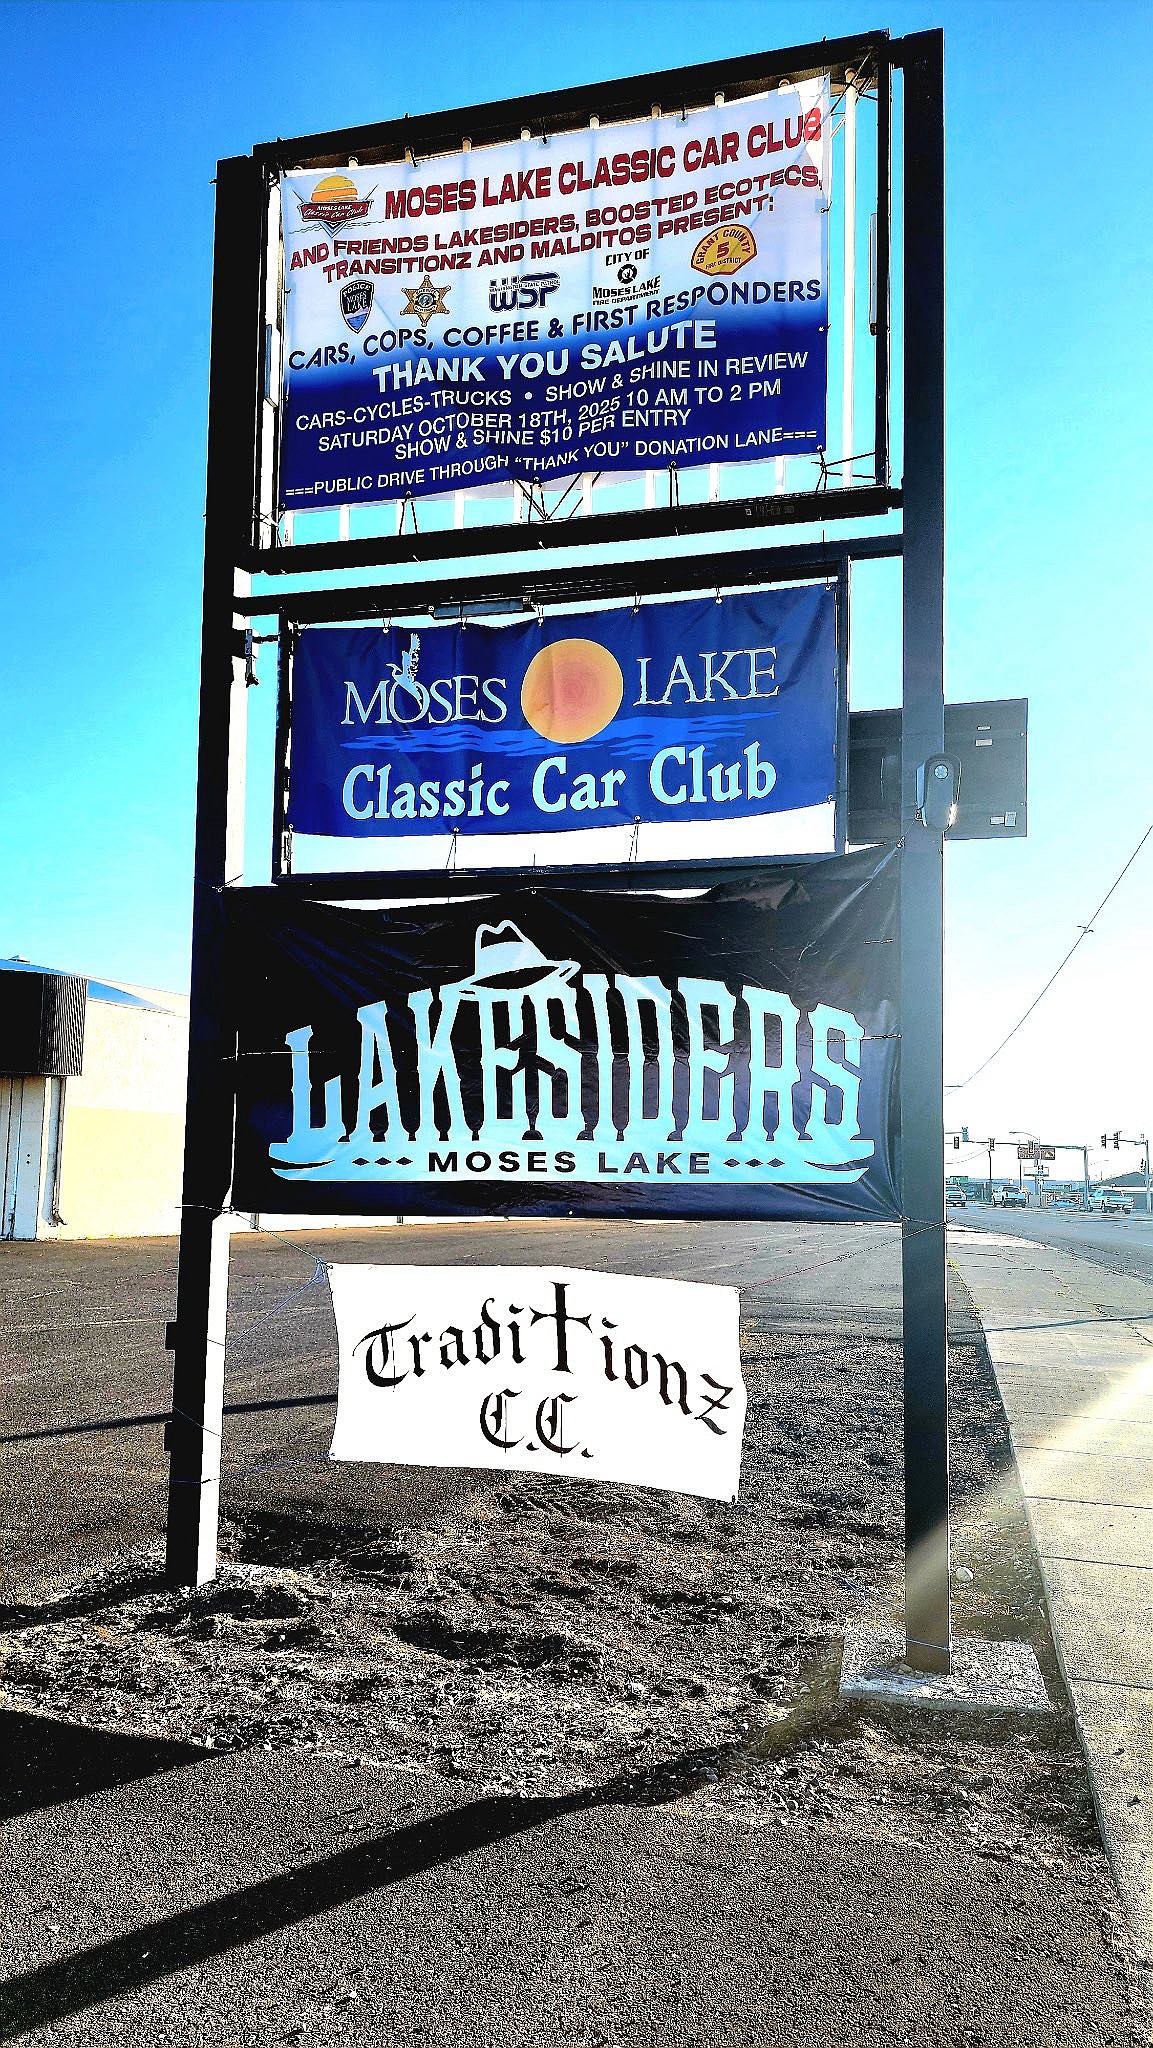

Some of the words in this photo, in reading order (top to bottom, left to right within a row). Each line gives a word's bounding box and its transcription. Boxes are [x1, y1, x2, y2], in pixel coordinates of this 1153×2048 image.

[385, 180, 476, 220] MOSES
[483, 167, 552, 207] LAKE
[559, 146, 676, 195] CLASSIC
[684, 132, 740, 173] CAR
[747, 107, 821, 159] CLUB
[290, 242, 330, 270] AND
[334, 234, 428, 256] FRIENDS
[435, 213, 580, 250] LAKESIDERS,
[586, 191, 697, 227] BOOSTED
[704, 165, 822, 205] ECOTECS,
[323, 252, 472, 283] TRANSITIONZ
[477, 244, 524, 268] AND
[531, 224, 652, 259] MALDITOS
[658, 194, 774, 239] PRESENT:
[696, 232, 718, 264] GRANT
[723, 229, 750, 253] COUNTY
[717, 241, 729, 258] 5
[343, 283, 370, 297] POLICE
[593, 287, 631, 299] MOSES
[633, 275, 660, 293] LAKE
[606, 252, 632, 266] CITY
[635, 248, 649, 260] OF
[289, 343, 356, 370] CARS,
[363, 329, 433, 356] COPS,
[443, 318, 539, 347] COFFEE
[548, 318, 564, 338] &
[572, 305, 638, 334] FIRST
[646, 280, 821, 320] RESPONDERS
[347, 291, 366, 303] MOSES
[348, 300, 368, 312] LAKE
[489, 272, 560, 313] WSP
[296, 390, 512, 431] CARS-CYCLES-TRUCKS
[546, 377, 606, 402] SHOW
[612, 374, 624, 389] &
[630, 360, 690, 384] SHINE
[698, 360, 717, 377] IN
[726, 351, 808, 375] REVIEW
[372, 357, 486, 393] THANK
[497, 349, 569, 380] YOU
[581, 320, 716, 370] SALUTE
[319, 424, 414, 451] SATURDAY
[419, 413, 512, 436] OCTOBER
[519, 410, 572, 428] 18TH,
[578, 393, 620, 420] 2025
[626, 389, 648, 406] 10
[655, 388, 688, 405] AM
[695, 385, 723, 403] TO
[730, 384, 742, 401] 2
[749, 379, 781, 399] PM
[395, 435, 450, 460] SHOW
[456, 433, 468, 448] &
[473, 429, 534, 446] SHINE
[540, 426, 572, 446] $10
[579, 415, 615, 437] PER
[622, 408, 691, 427] ENTRY
[377, 469, 424, 488] DRIVE
[429, 456, 508, 480] THROUGH
[635, 435, 728, 456] DONATION
[341, 676, 507, 725] MOSES
[633, 647, 780, 706] LAKE
[342, 763, 510, 820] Classic
[532, 756, 627, 813] Car
[650, 741, 777, 804] Club
[283, 973, 866, 1143] LAKESIDERS
[428, 1150, 577, 1174] MOSES
[598, 1152, 710, 1174] LAKE
[352, 1281, 734, 1436] Traditionz
[480, 1388, 594, 1458] C.C.
